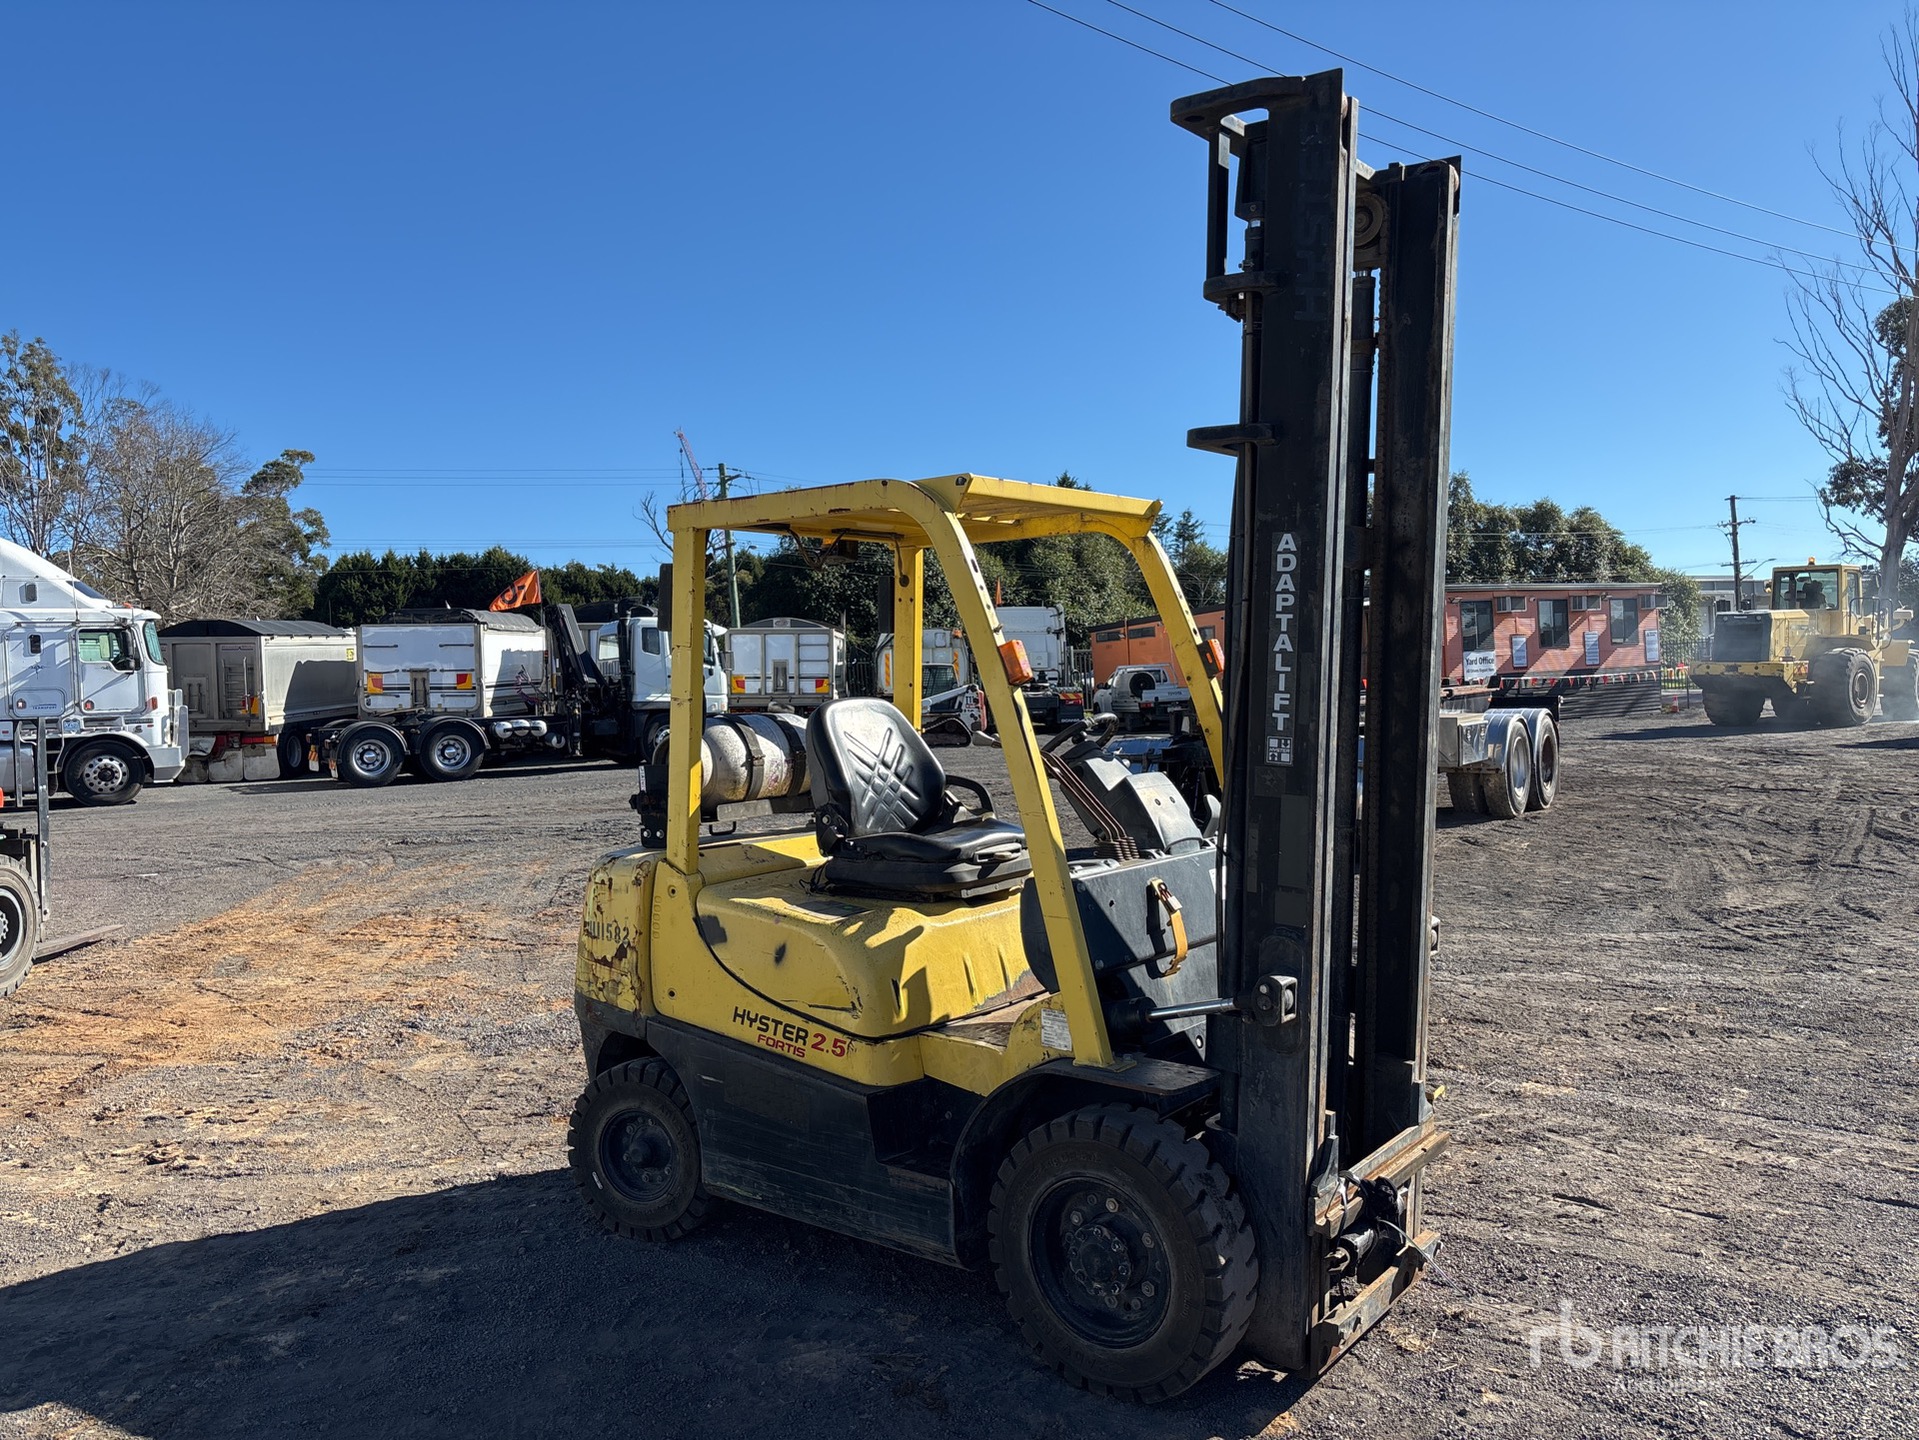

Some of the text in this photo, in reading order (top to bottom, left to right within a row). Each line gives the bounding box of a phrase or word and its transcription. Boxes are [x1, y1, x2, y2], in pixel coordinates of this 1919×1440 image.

[1271, 532, 1298, 731] ADAPTALIFT
[1465, 656, 1494, 665] Yard Office
[733, 1006, 809, 1046] HYSTER
[757, 1034, 806, 1058] FORTIS
[811, 1033, 847, 1058] 2.5
